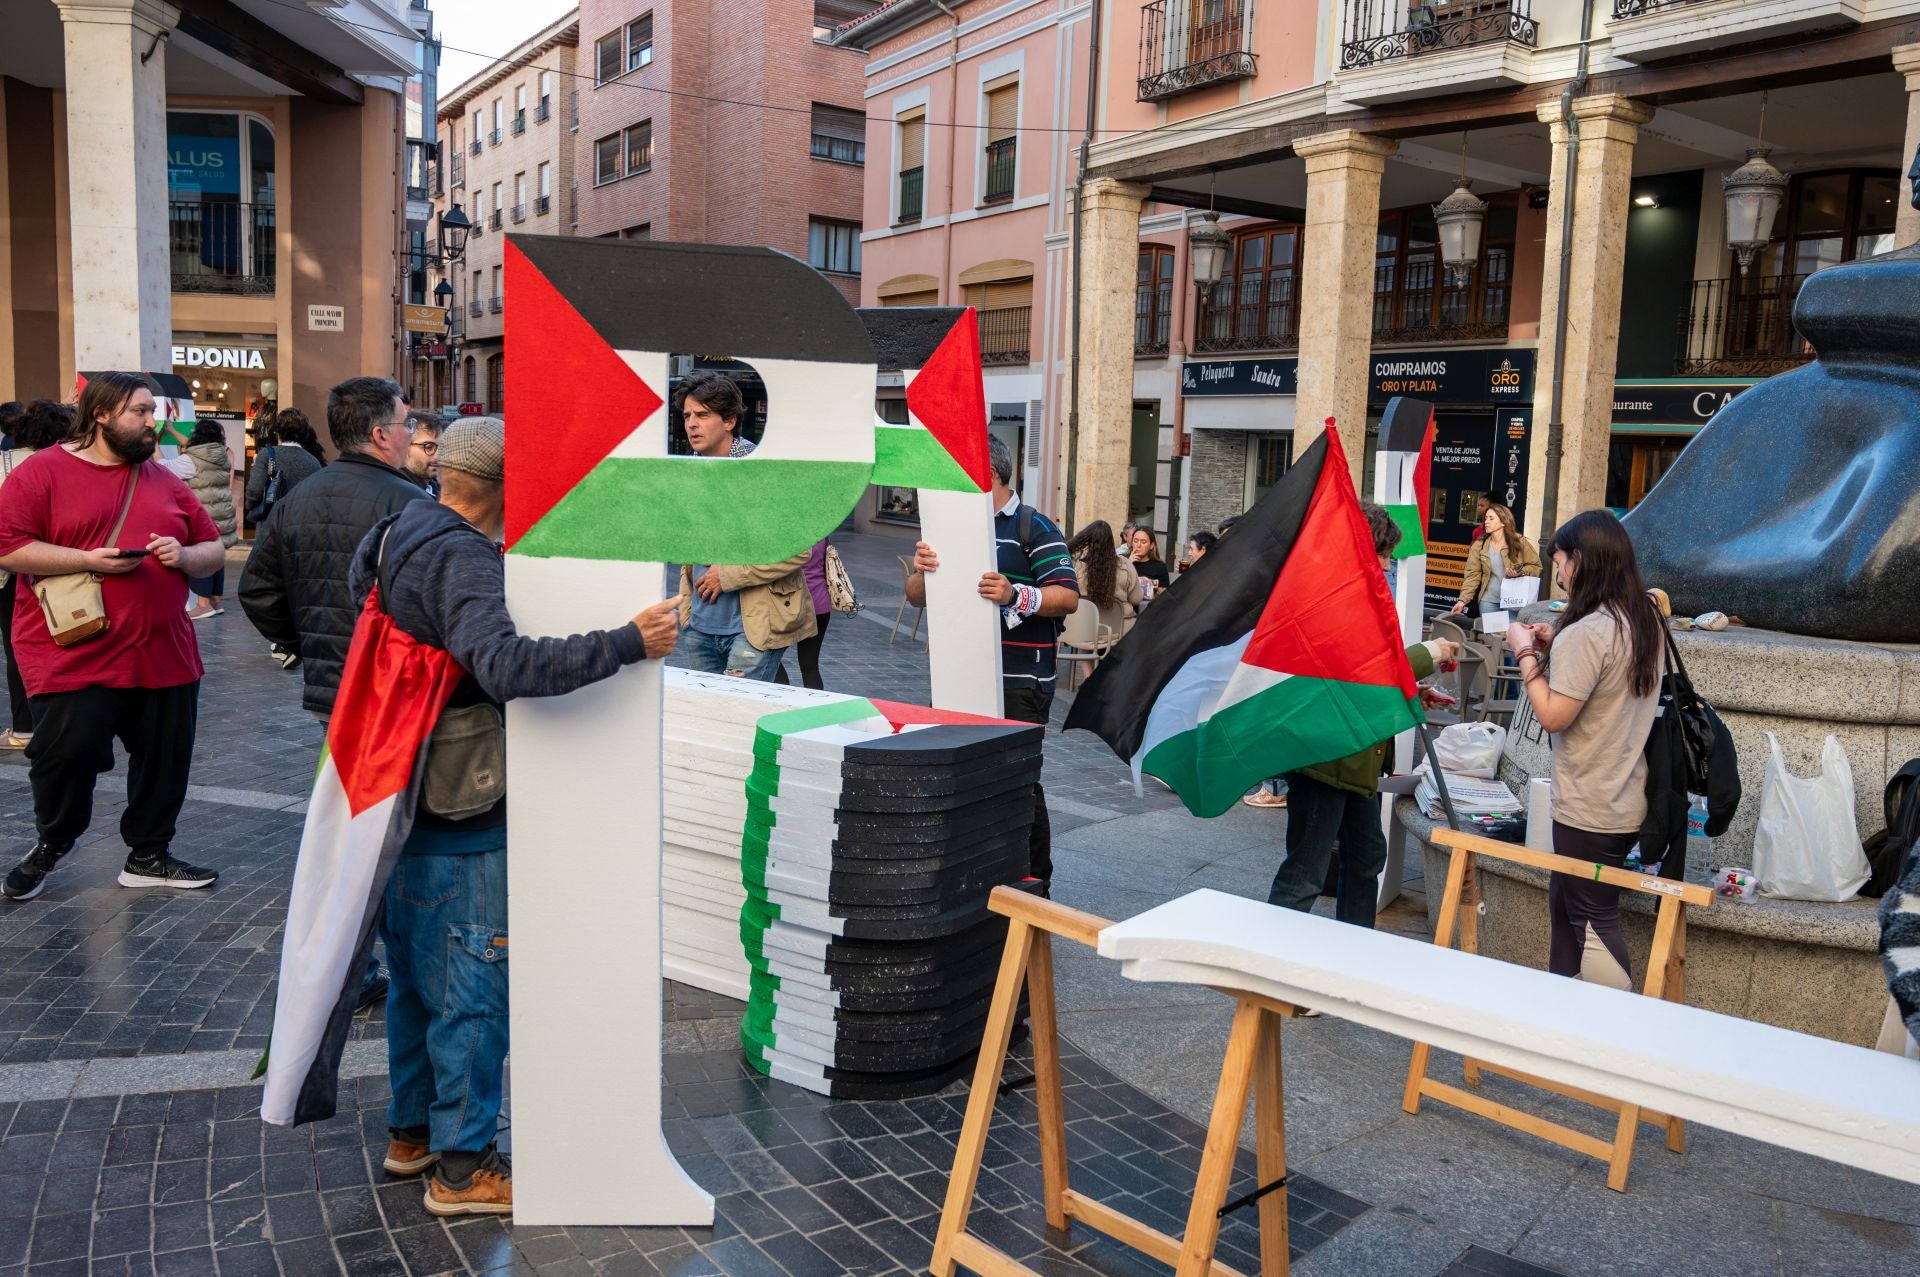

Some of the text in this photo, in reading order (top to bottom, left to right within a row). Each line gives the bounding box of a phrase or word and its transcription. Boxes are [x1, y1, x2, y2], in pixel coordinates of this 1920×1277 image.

[171, 346, 266, 369] EDONIA
[1376, 361, 1446, 376] COMPRAMOS
[1250, 364, 1281, 388] Sandra
[1491, 373, 1520, 385] ORO
[1381, 380, 1437, 392] ORO Y PLATA
[1436, 446, 1454, 454] VENTA
[1462, 447, 1480, 455] JOYAS
[1441, 455, 1460, 463] MEJOR
[1460, 456, 1481, 464] PRECIO
